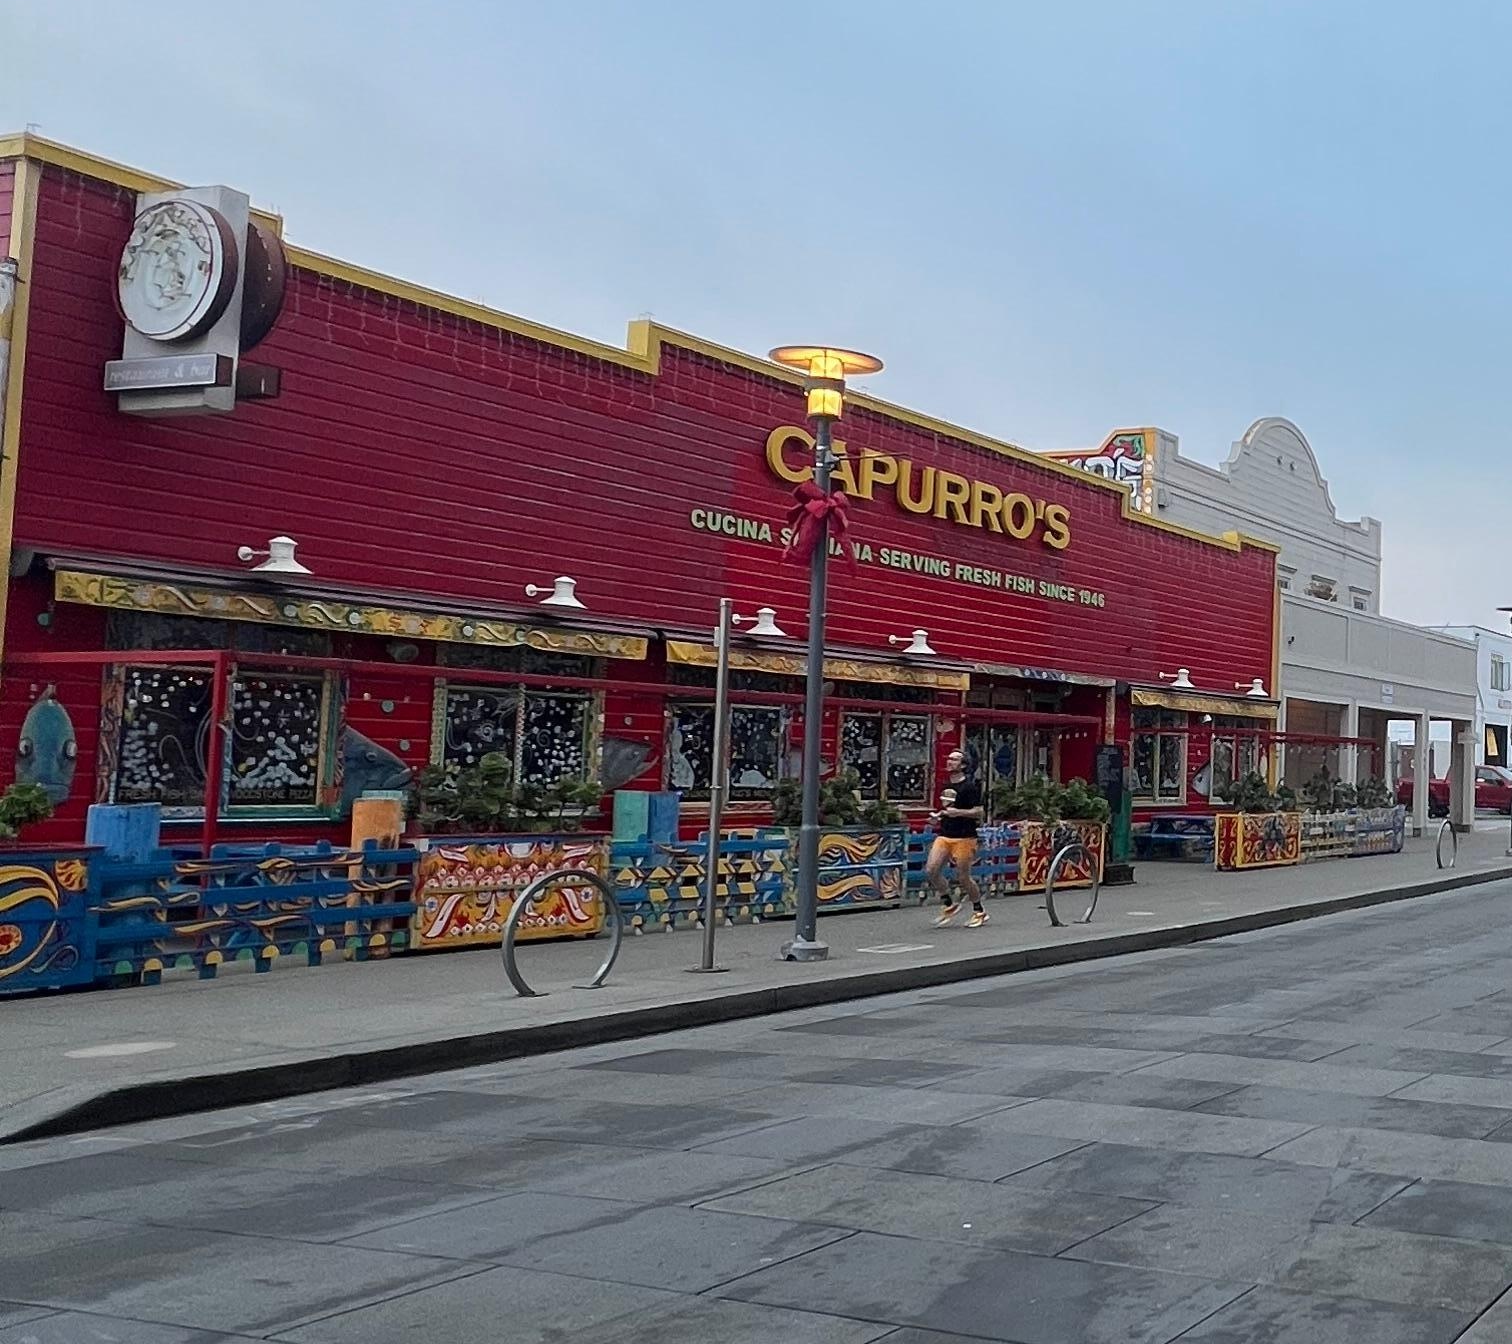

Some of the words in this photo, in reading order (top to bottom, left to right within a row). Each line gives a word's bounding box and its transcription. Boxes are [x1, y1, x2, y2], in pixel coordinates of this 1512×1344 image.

[766, 425, 1071, 549] CAPURRO'S
[691, 509, 772, 543] CUCINA
[880, 548, 950, 576] SERVING
[955, 564, 1001, 587] FRESH
[1005, 574, 1034, 594] FISH
[1039, 581, 1075, 602] SINCE
[1078, 589, 1105, 608] 1946
